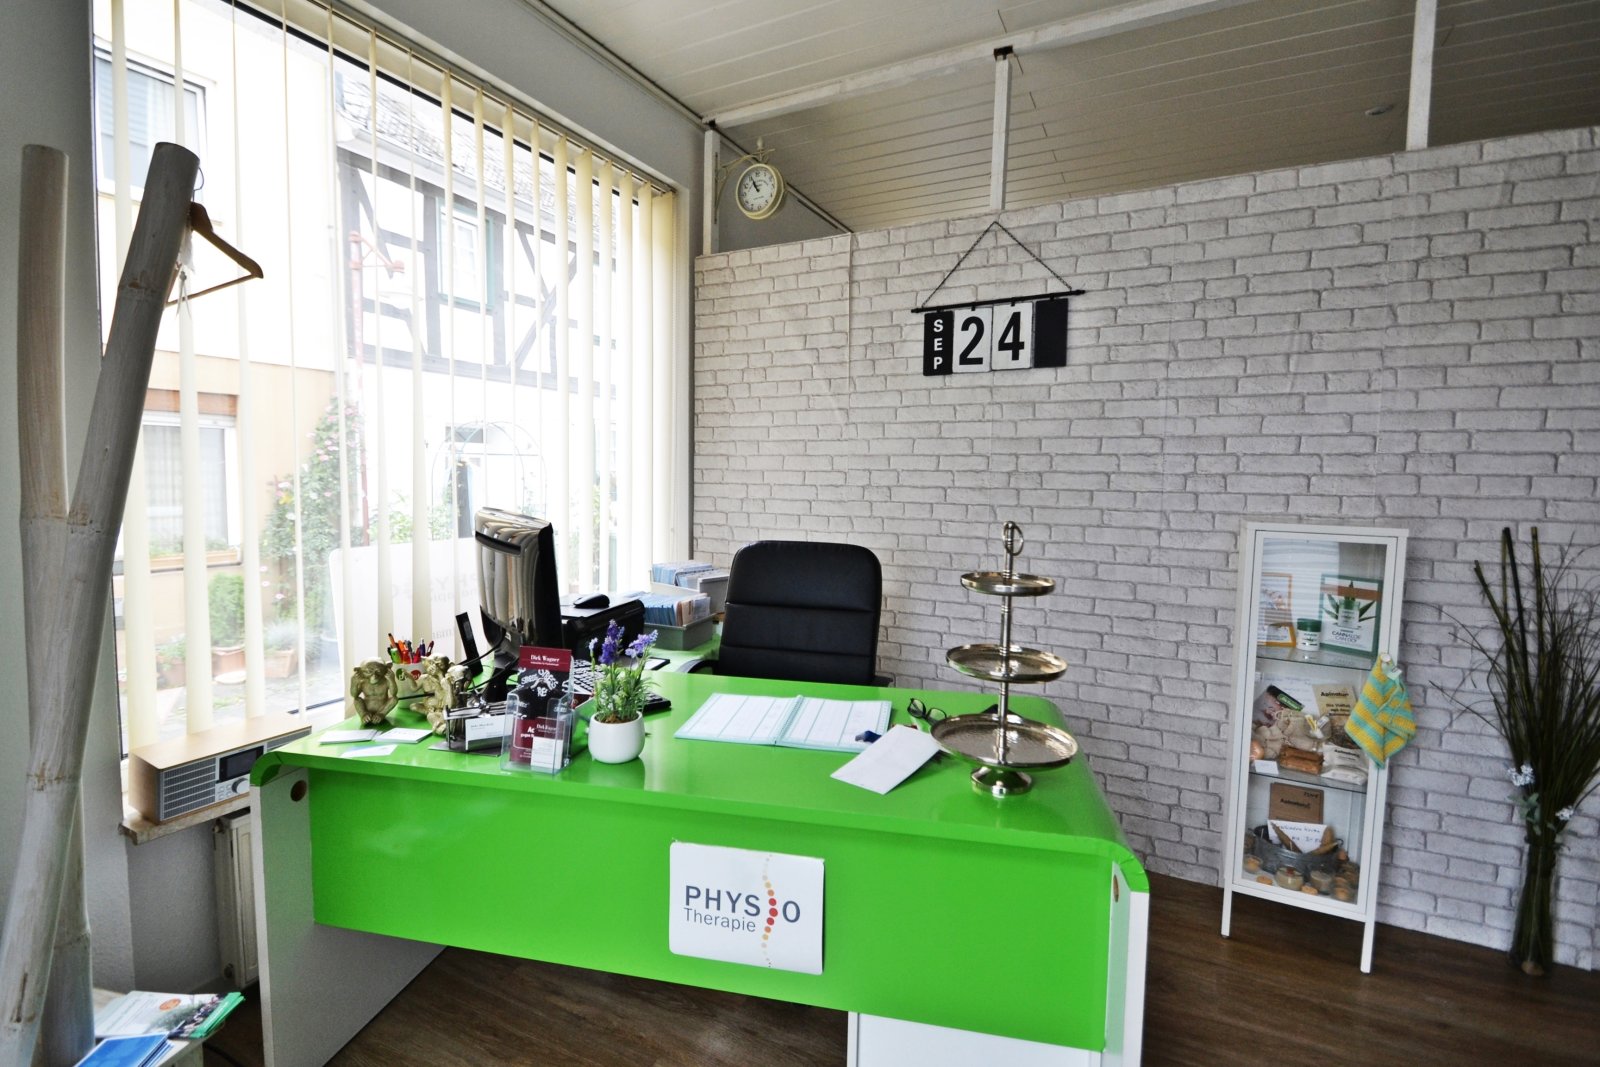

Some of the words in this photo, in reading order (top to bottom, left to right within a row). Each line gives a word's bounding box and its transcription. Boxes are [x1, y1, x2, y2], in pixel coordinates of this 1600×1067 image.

[933, 319, 944, 370] SEP
[958, 311, 1025, 366] 24
[684, 907, 756, 933] Therapie
